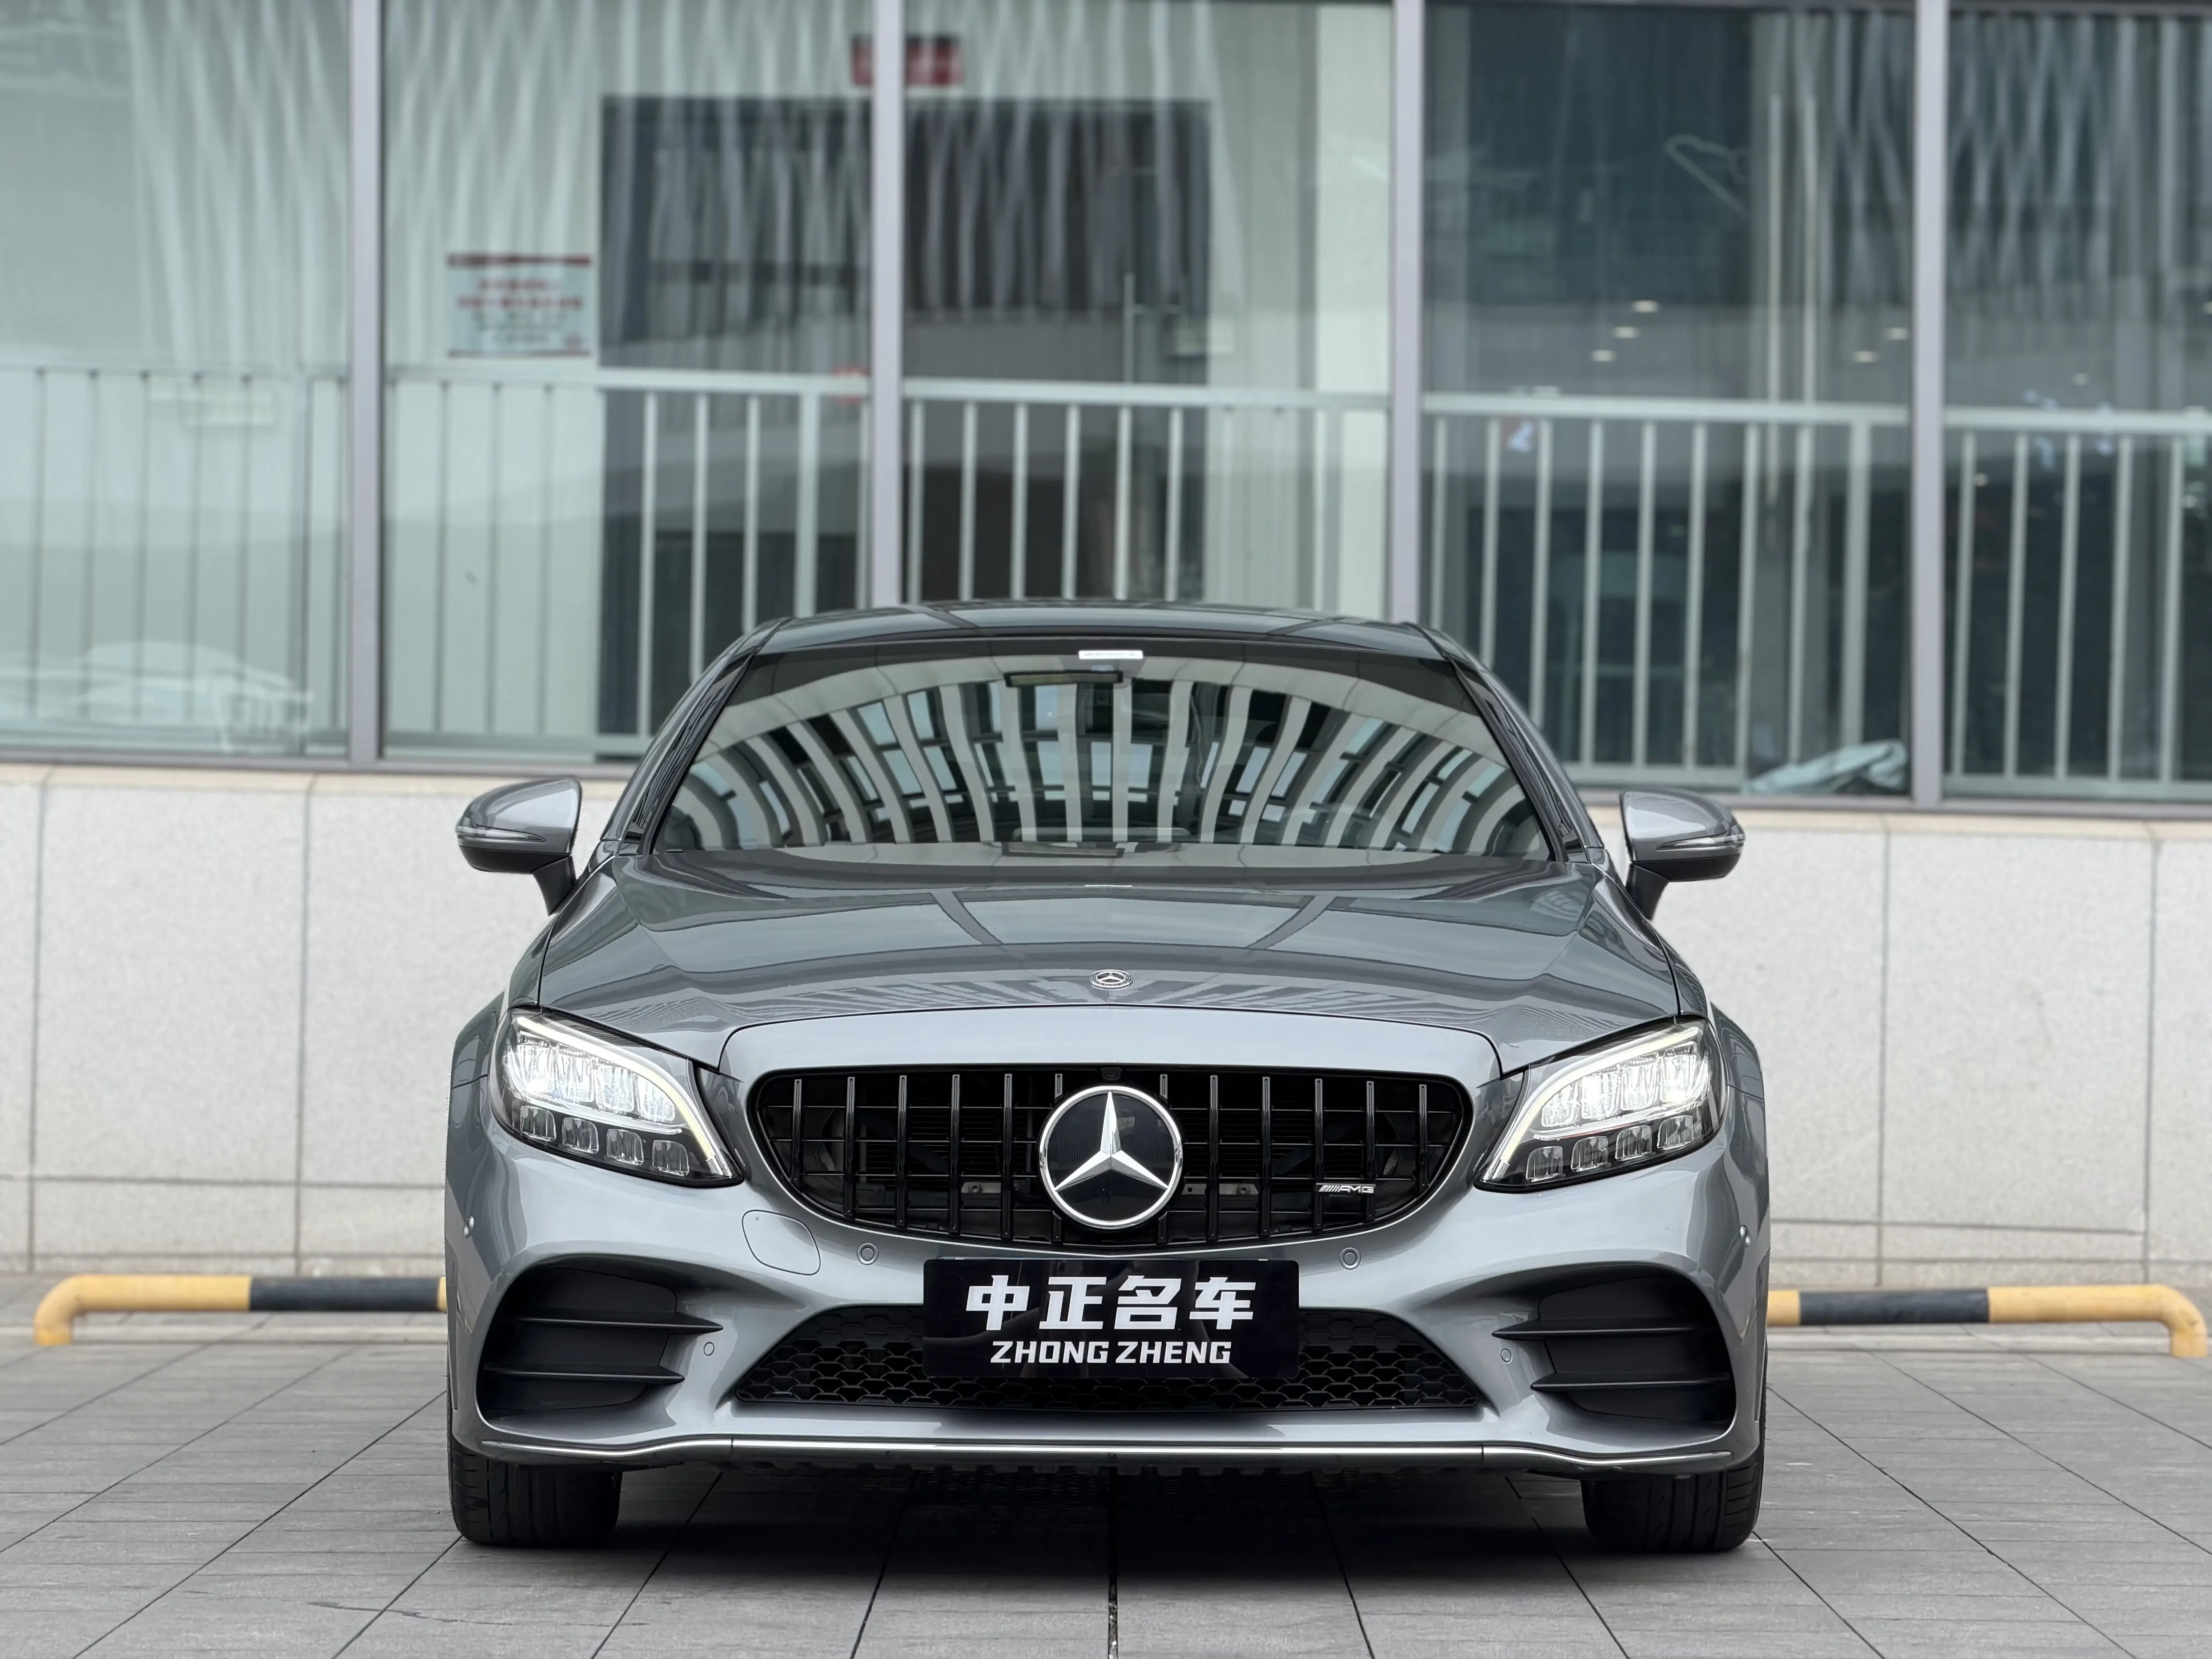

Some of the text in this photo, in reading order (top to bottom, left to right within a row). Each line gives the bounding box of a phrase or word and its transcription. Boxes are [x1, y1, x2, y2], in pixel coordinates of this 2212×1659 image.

[1338, 1185, 1374, 1194] AMG
[966, 1275, 1256, 1331] 中正名车
[990, 1341, 1231, 1364] ZHONG ZHENG
